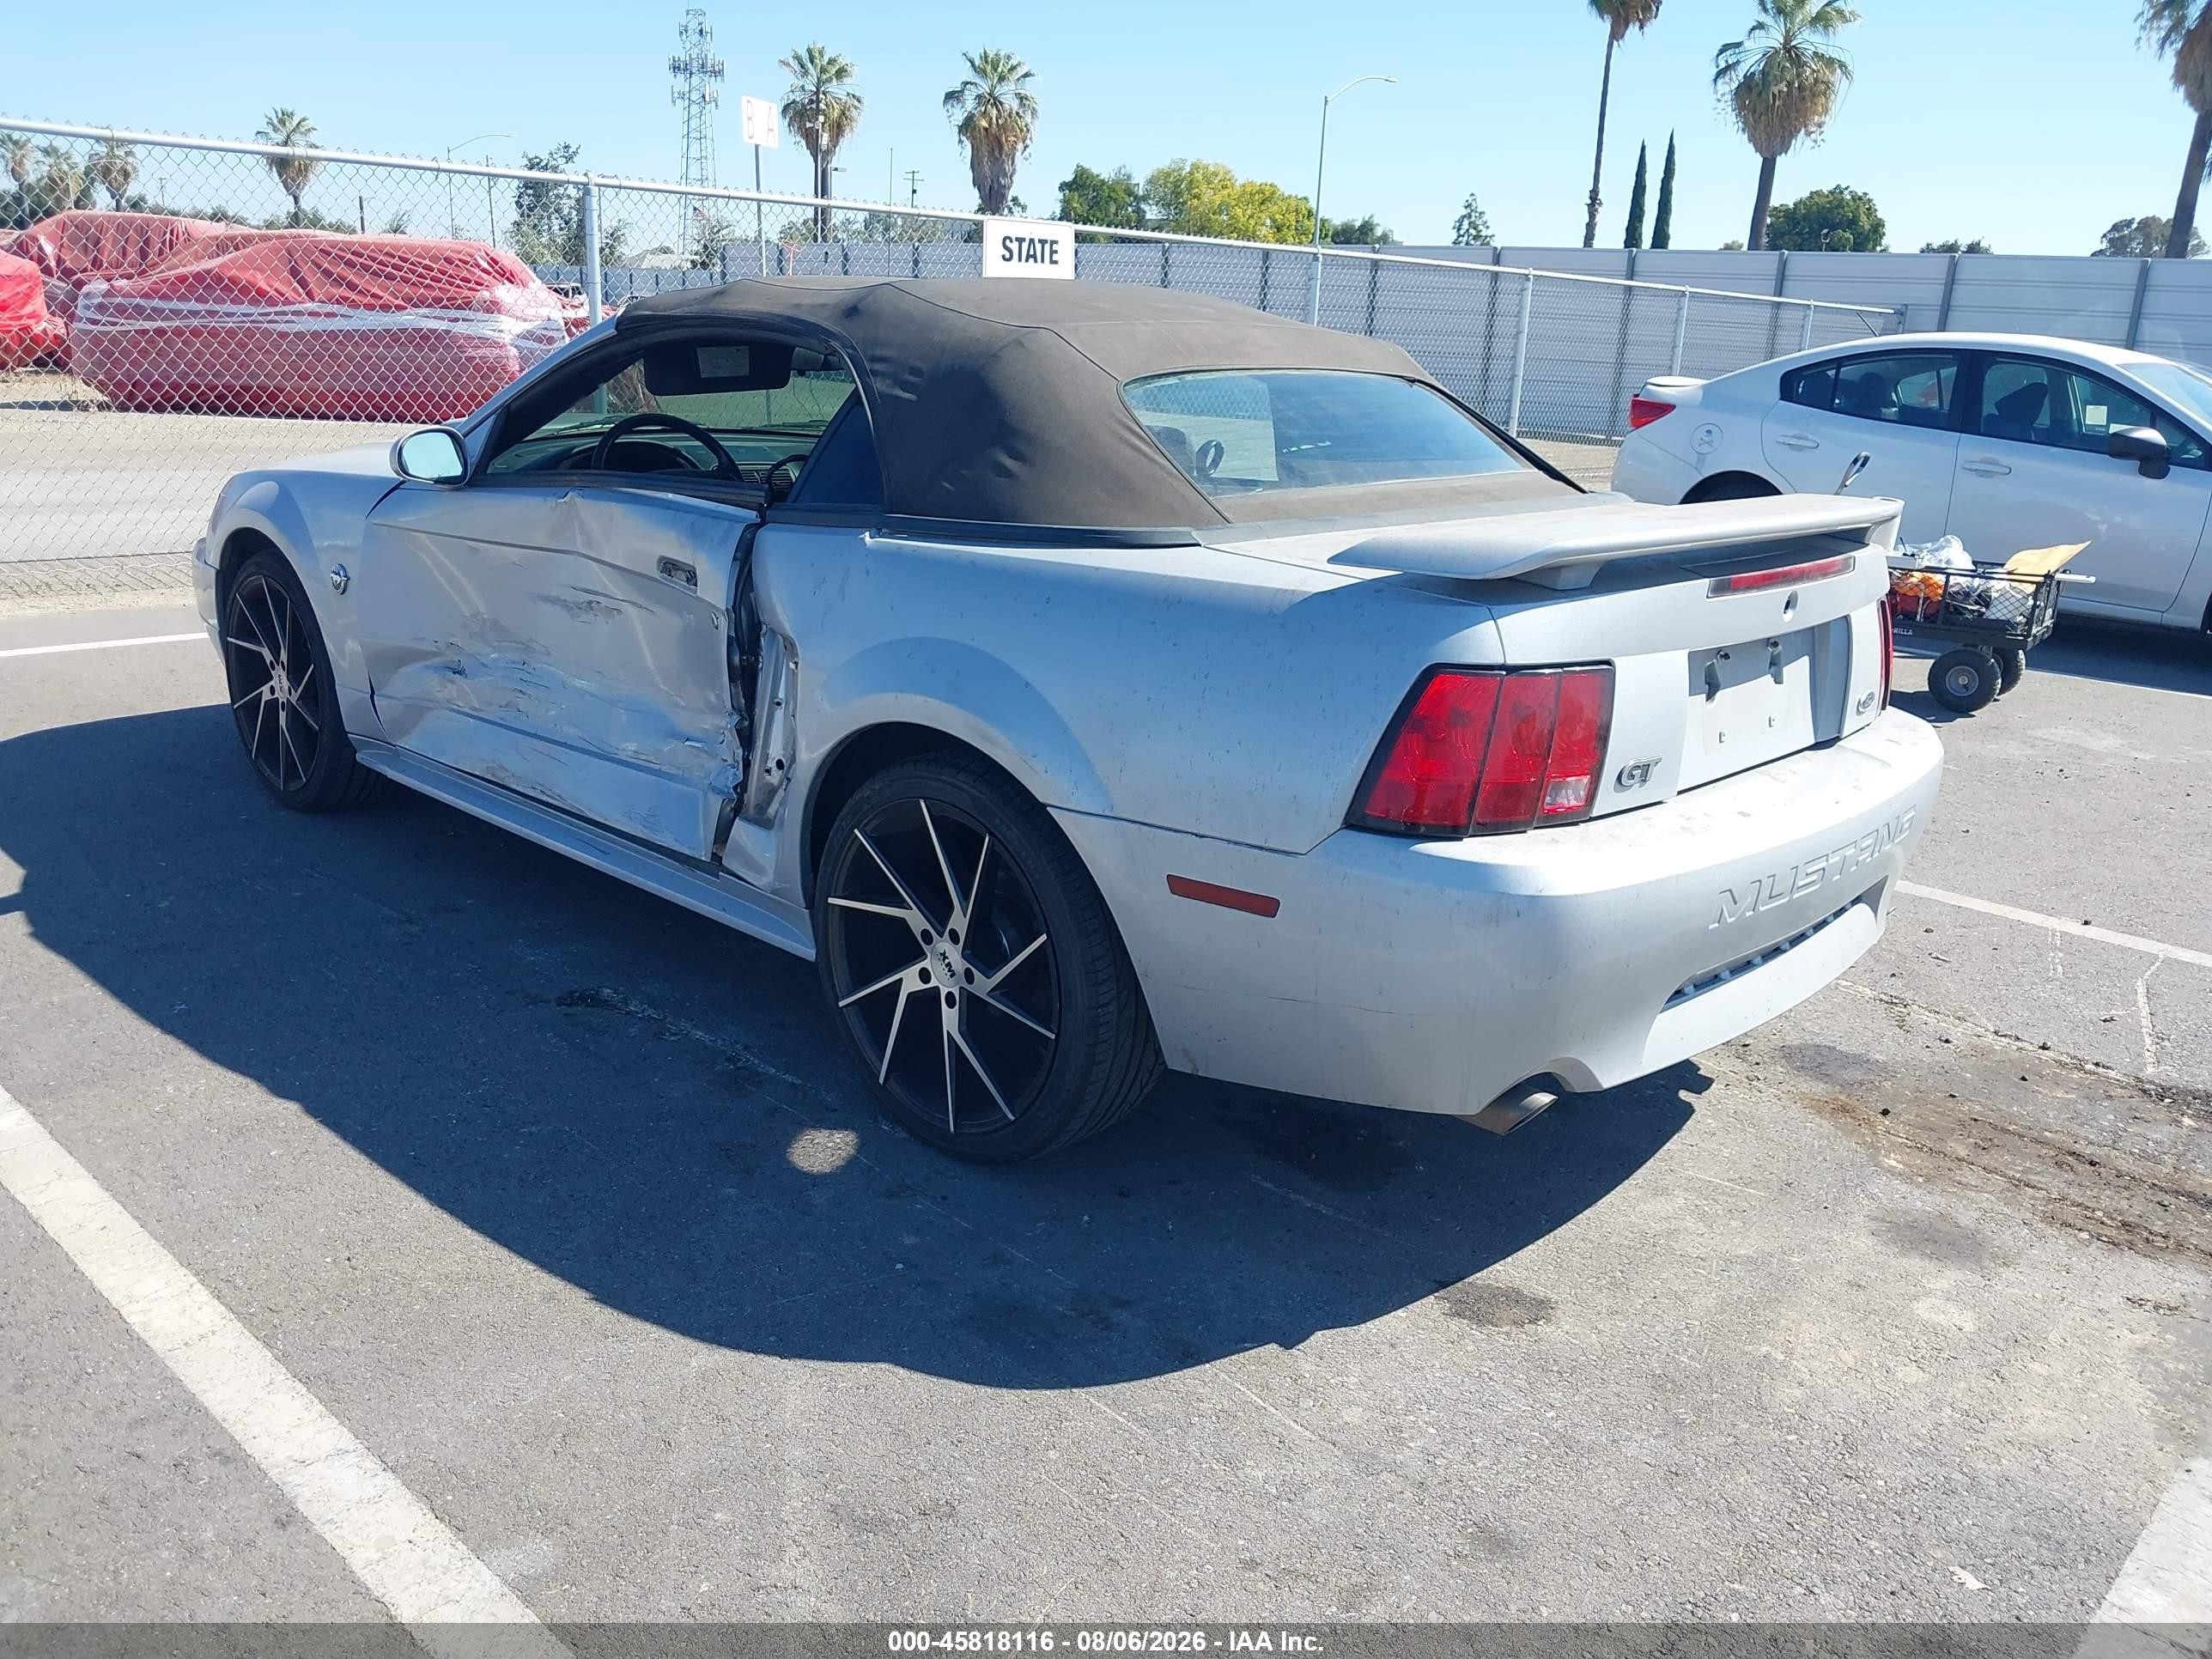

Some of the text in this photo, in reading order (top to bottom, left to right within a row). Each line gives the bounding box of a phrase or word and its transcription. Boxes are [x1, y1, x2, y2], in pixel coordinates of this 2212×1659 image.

[1001, 235, 1060, 264] STATE
[1620, 756, 1663, 786] GT
[1708, 803, 1917, 930] MUSTANG
